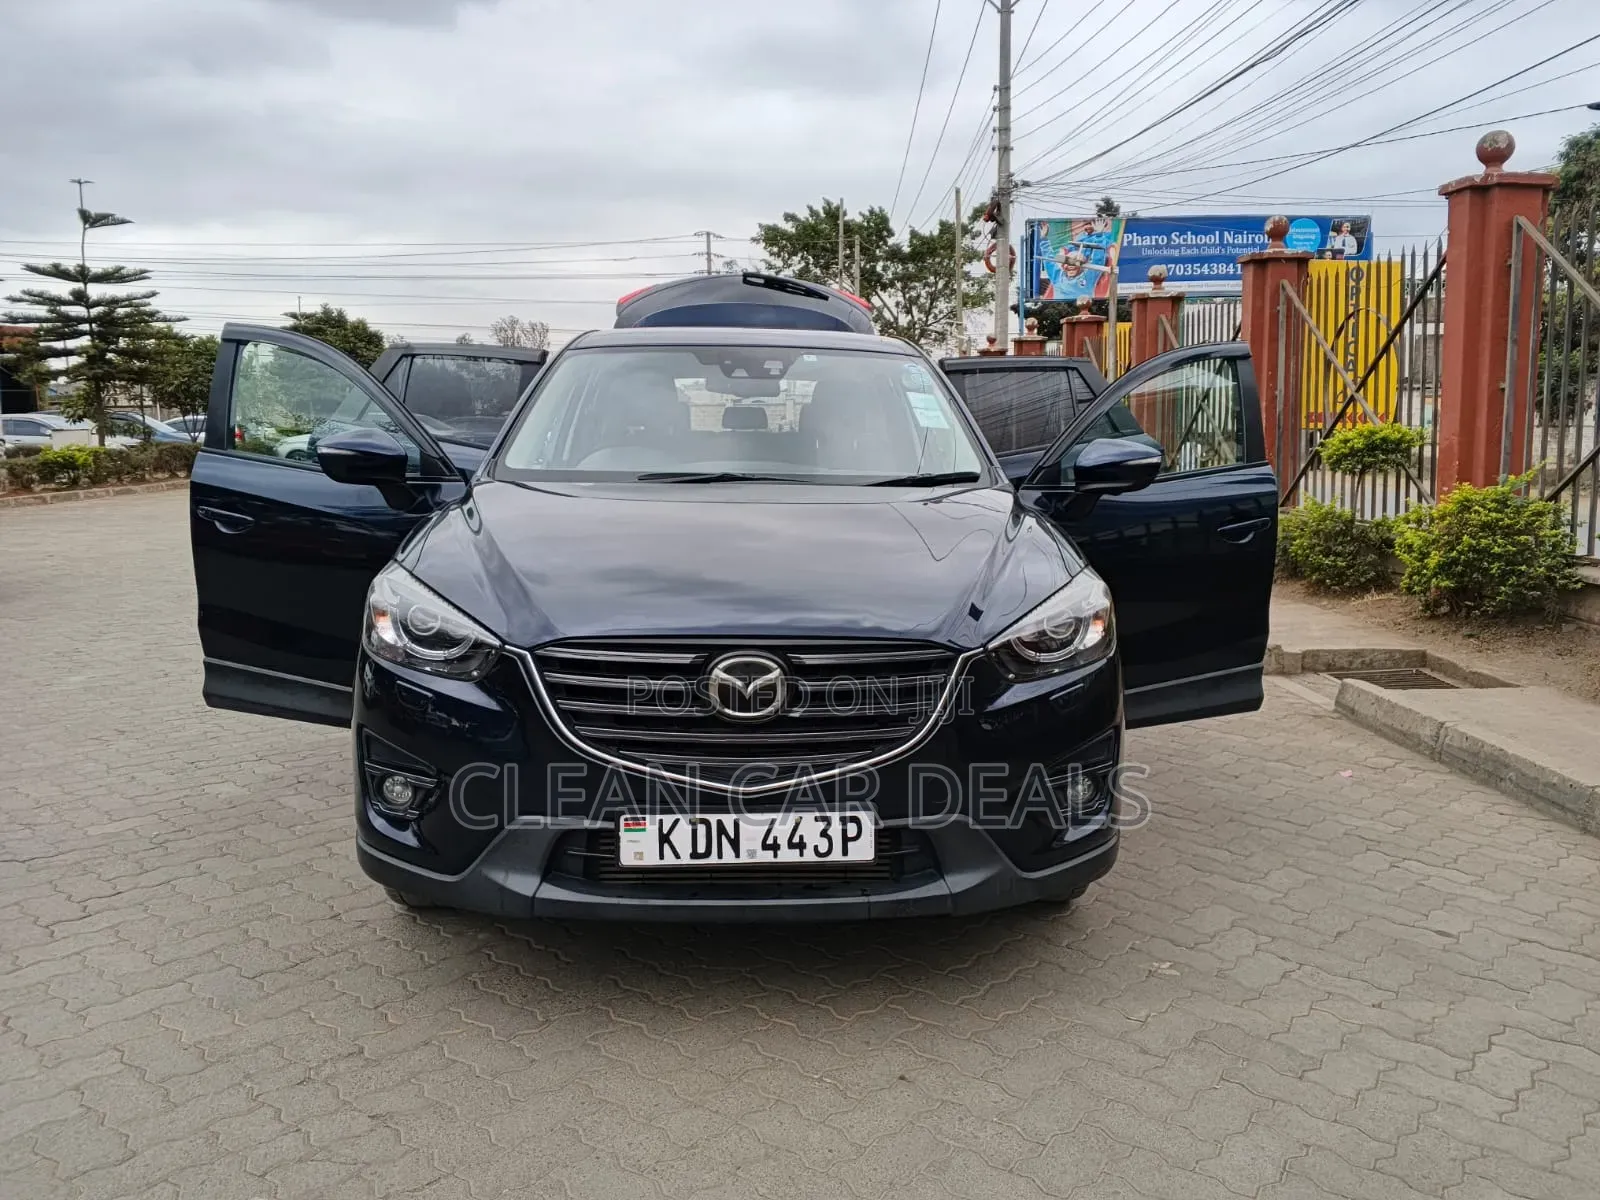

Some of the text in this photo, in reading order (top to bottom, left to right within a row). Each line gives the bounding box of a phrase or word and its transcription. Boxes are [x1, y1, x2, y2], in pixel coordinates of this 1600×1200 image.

[1123, 232, 1168, 246] Pharo
[1171, 231, 1219, 245] School
[1142, 246, 1260, 257] Unlocking Each Child's Potential
[1160, 263, 1243, 275] 703543841
[657, 817, 741, 861] KDN
[760, 815, 863, 859] 443P
